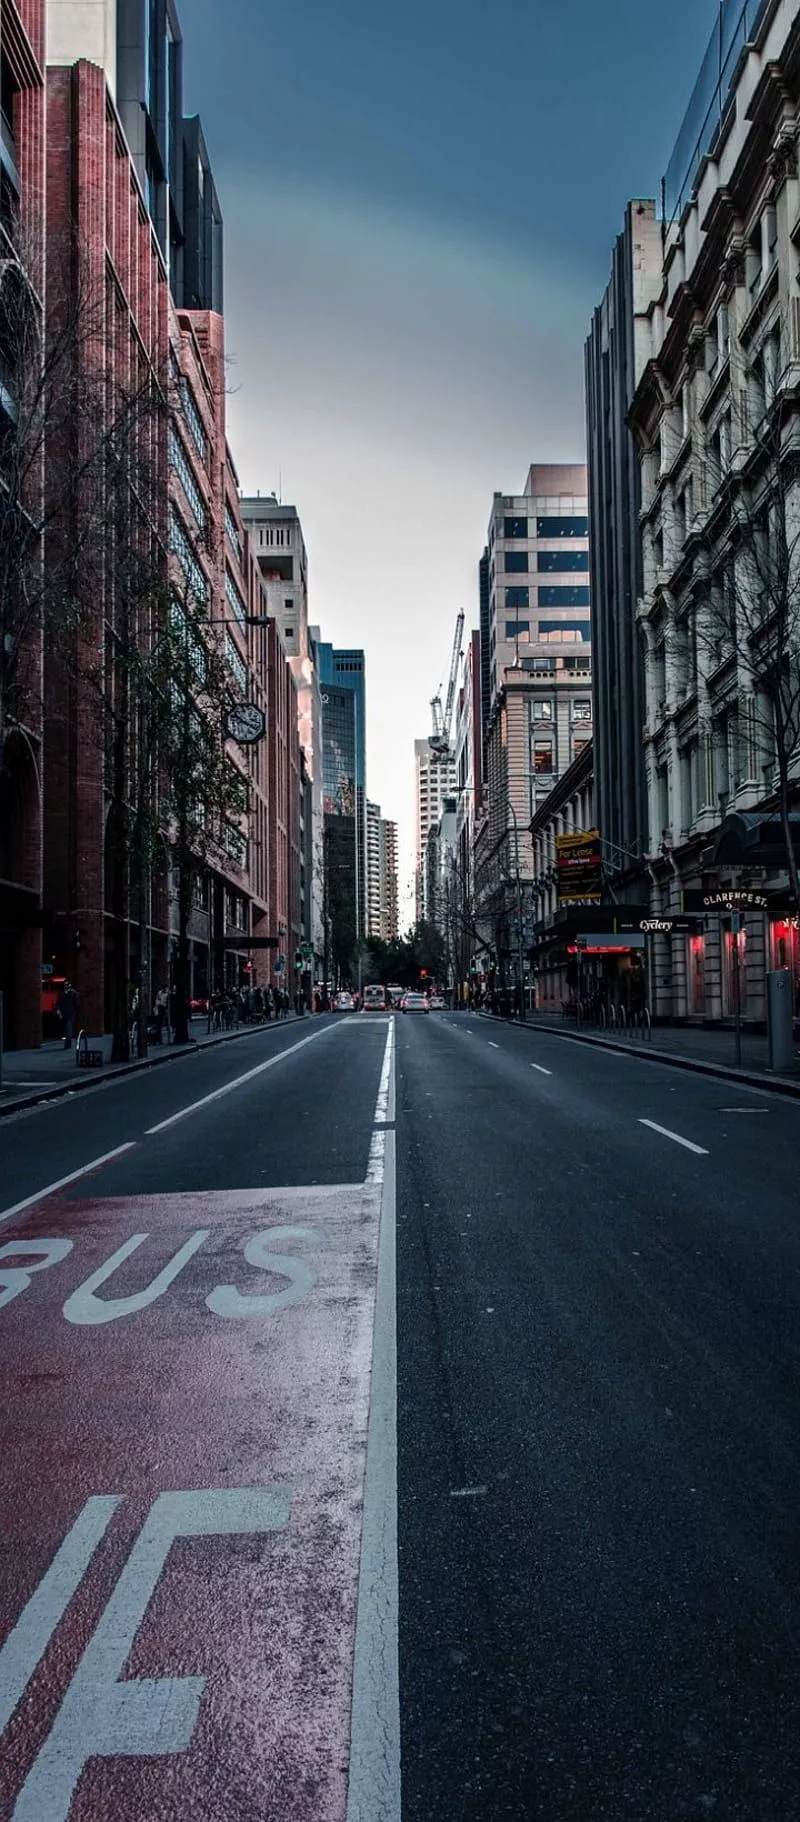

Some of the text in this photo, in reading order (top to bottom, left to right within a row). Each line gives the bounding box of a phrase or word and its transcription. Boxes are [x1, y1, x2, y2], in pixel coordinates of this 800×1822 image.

[559, 850, 571, 858] For
[703, 891, 754, 906] CLARENCE
[639, 919, 673, 932] Cyclery
[0, 1225, 321, 1325] BUS
